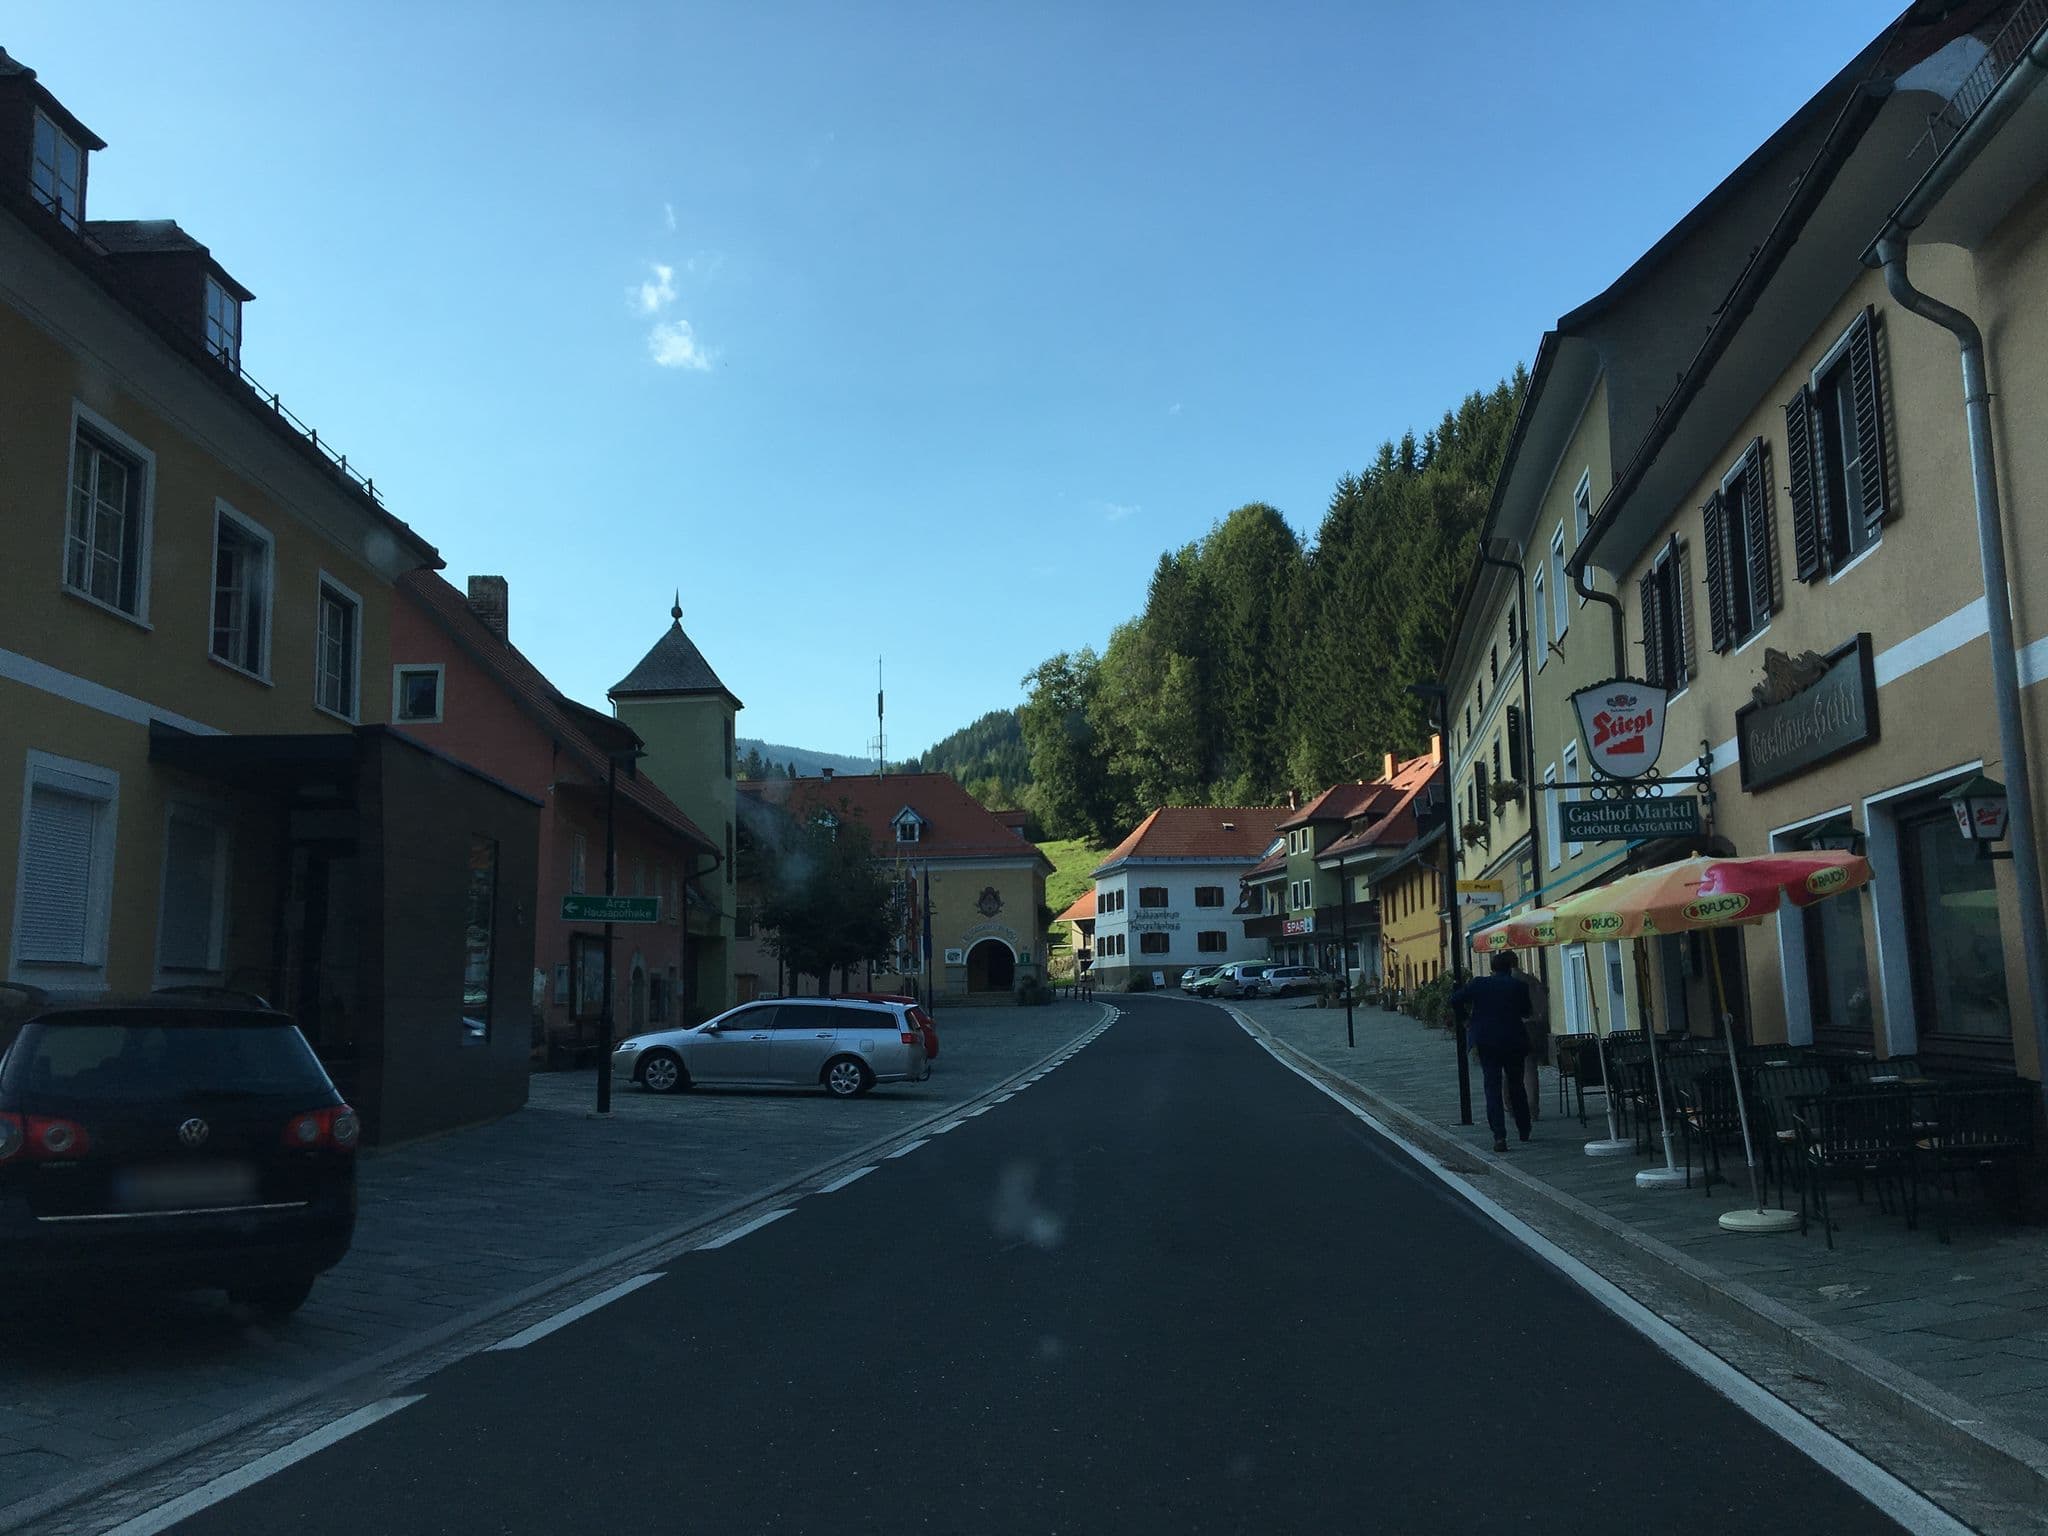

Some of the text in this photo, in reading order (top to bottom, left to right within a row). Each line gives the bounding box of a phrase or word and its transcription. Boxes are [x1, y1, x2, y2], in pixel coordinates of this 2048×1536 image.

[1593, 708, 1653, 747] Stiegl
[1568, 801, 1692, 823] Gasthof Marktl
[1623, 820, 1693, 834] GASTGARTEN
[1818, 871, 1846, 888] RAUCH
[606, 898, 631, 908] Arzt
[1699, 896, 1742, 917] RAUCH
[584, 906, 652, 920] Hausapotheke
[1287, 920, 1305, 933] SPAR
[1592, 916, 1620, 930] RAUCH
